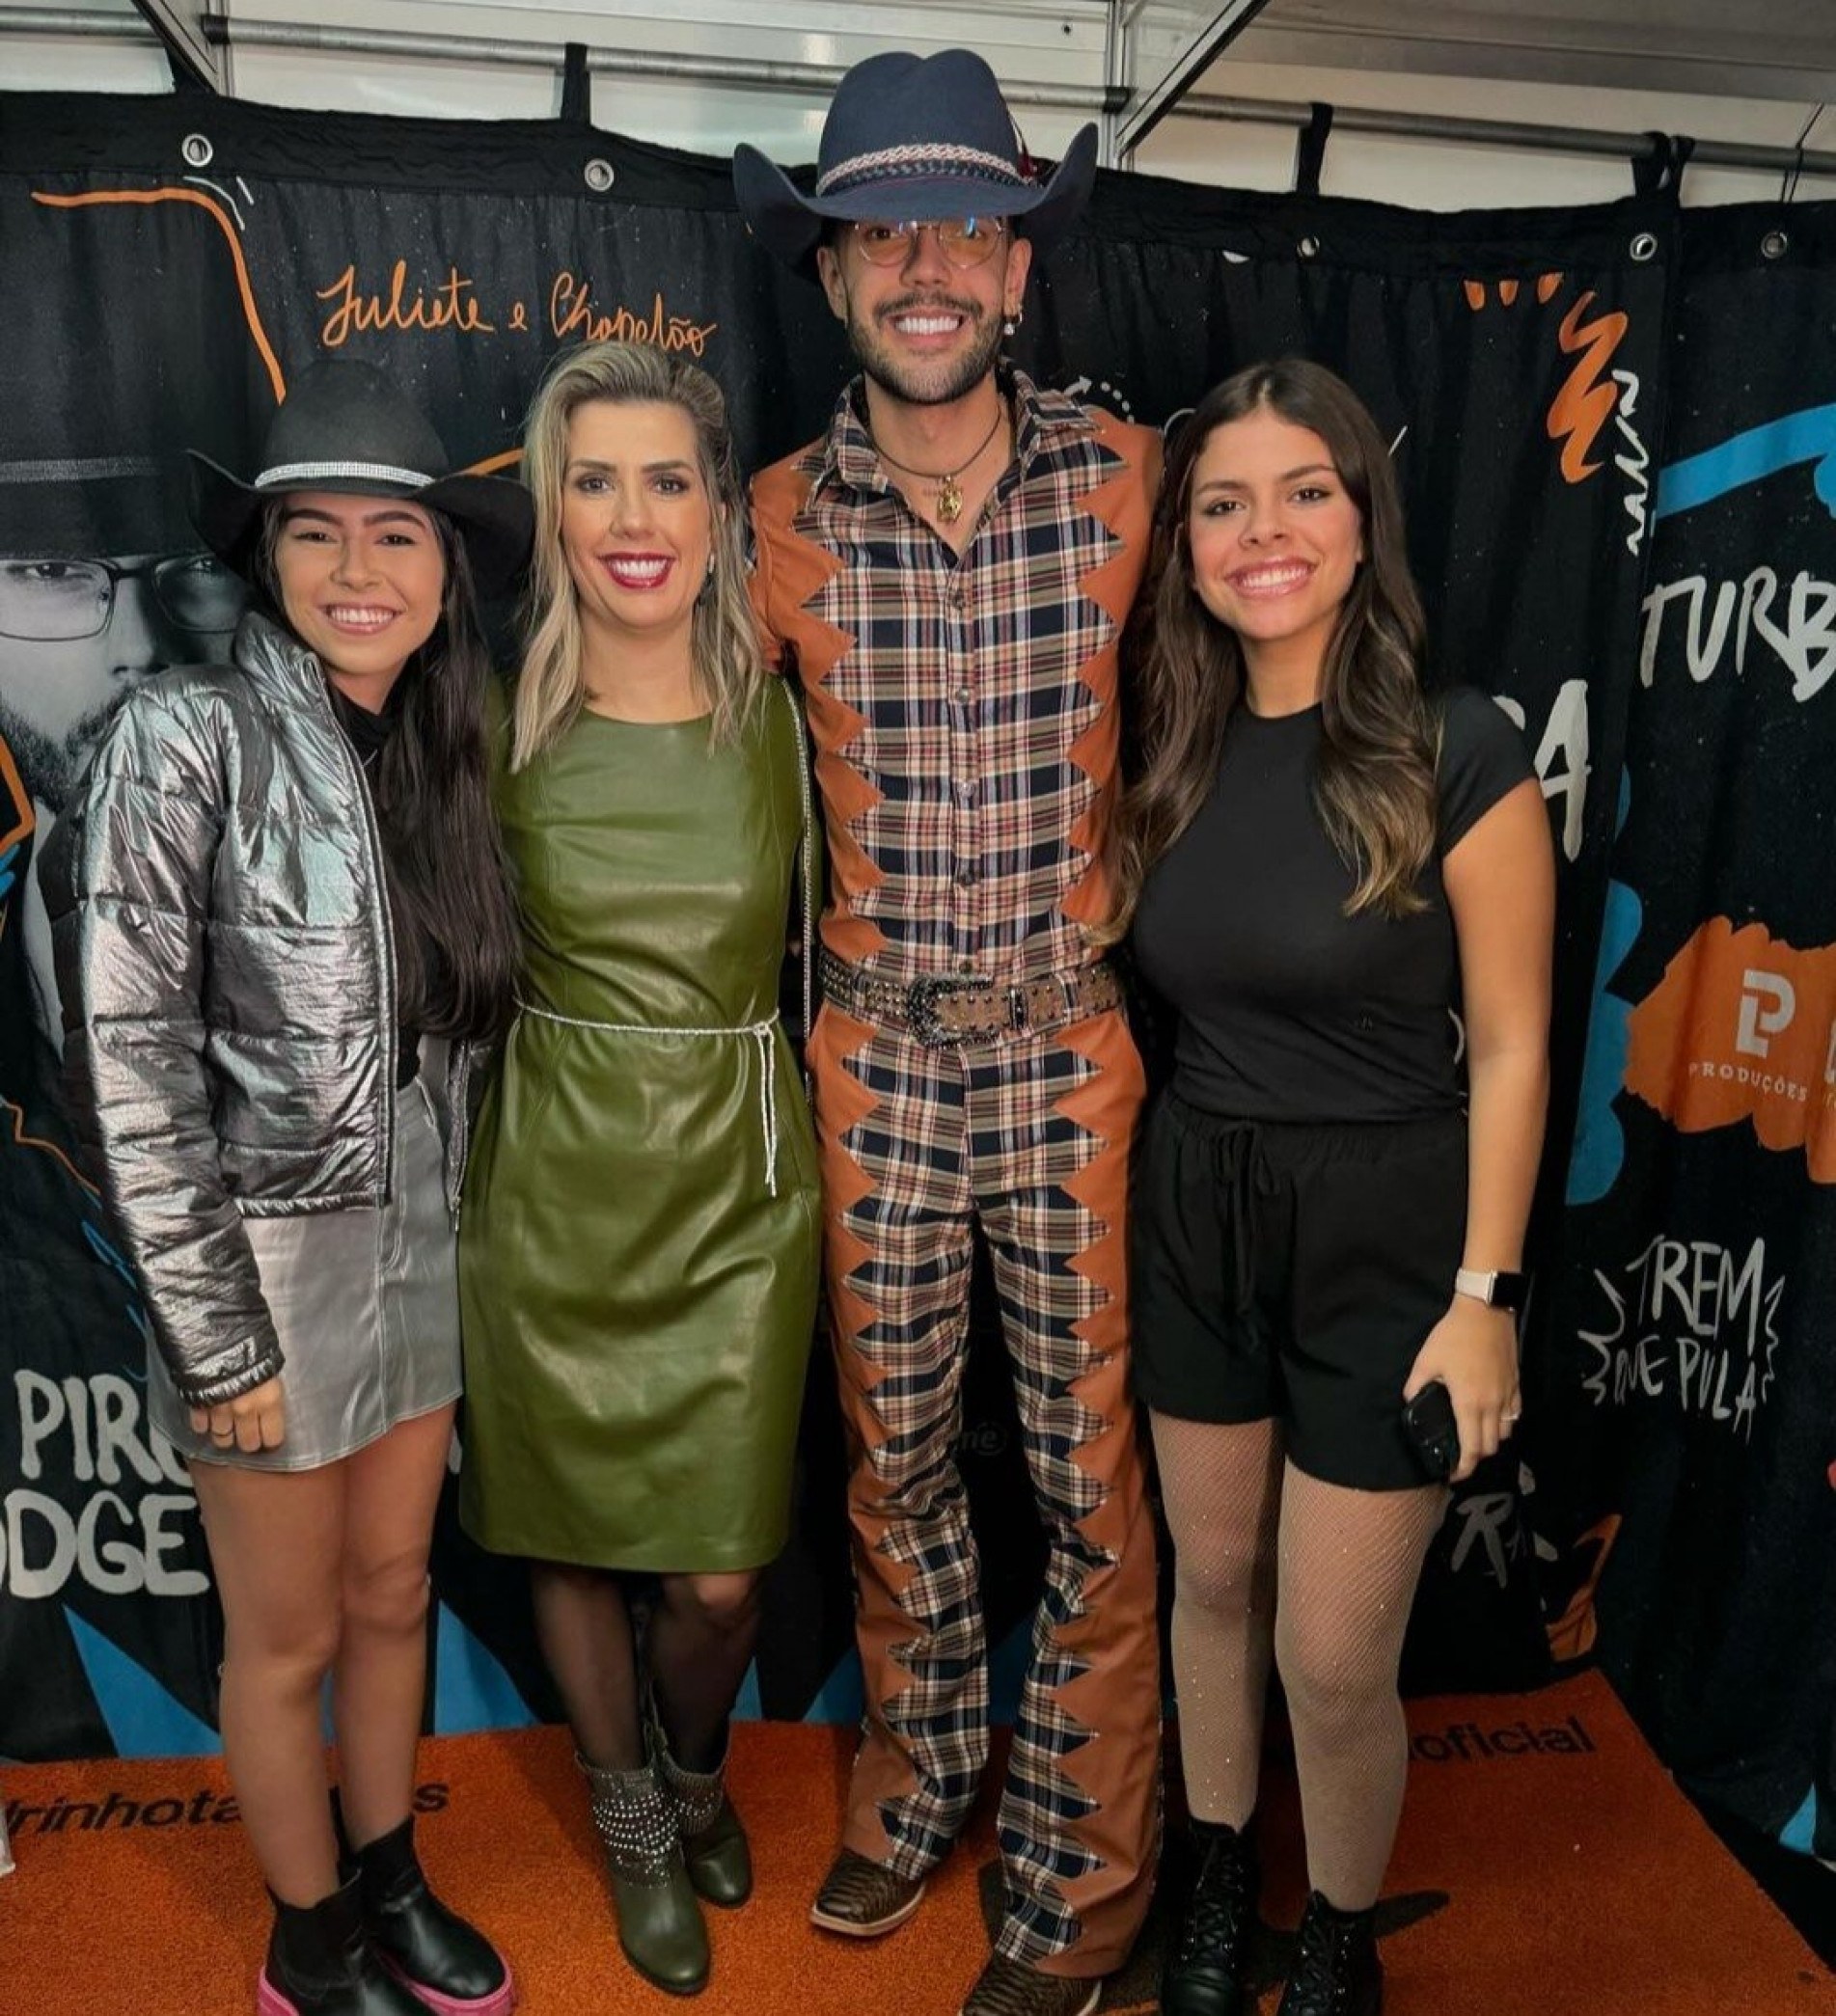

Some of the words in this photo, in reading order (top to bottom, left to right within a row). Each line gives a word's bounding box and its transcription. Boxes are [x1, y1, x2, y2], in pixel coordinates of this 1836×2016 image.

[316, 259, 496, 347] Juliete
[508, 302, 527, 331] e
[1688, 1061, 1808, 1103] PRODUÇÕES
[1625, 1234, 1766, 1358] TREM
[1675, 1337, 1757, 1445] PULA
[0, 1488, 210, 1599] DGE
[1408, 1715, 1597, 1762] oficial
